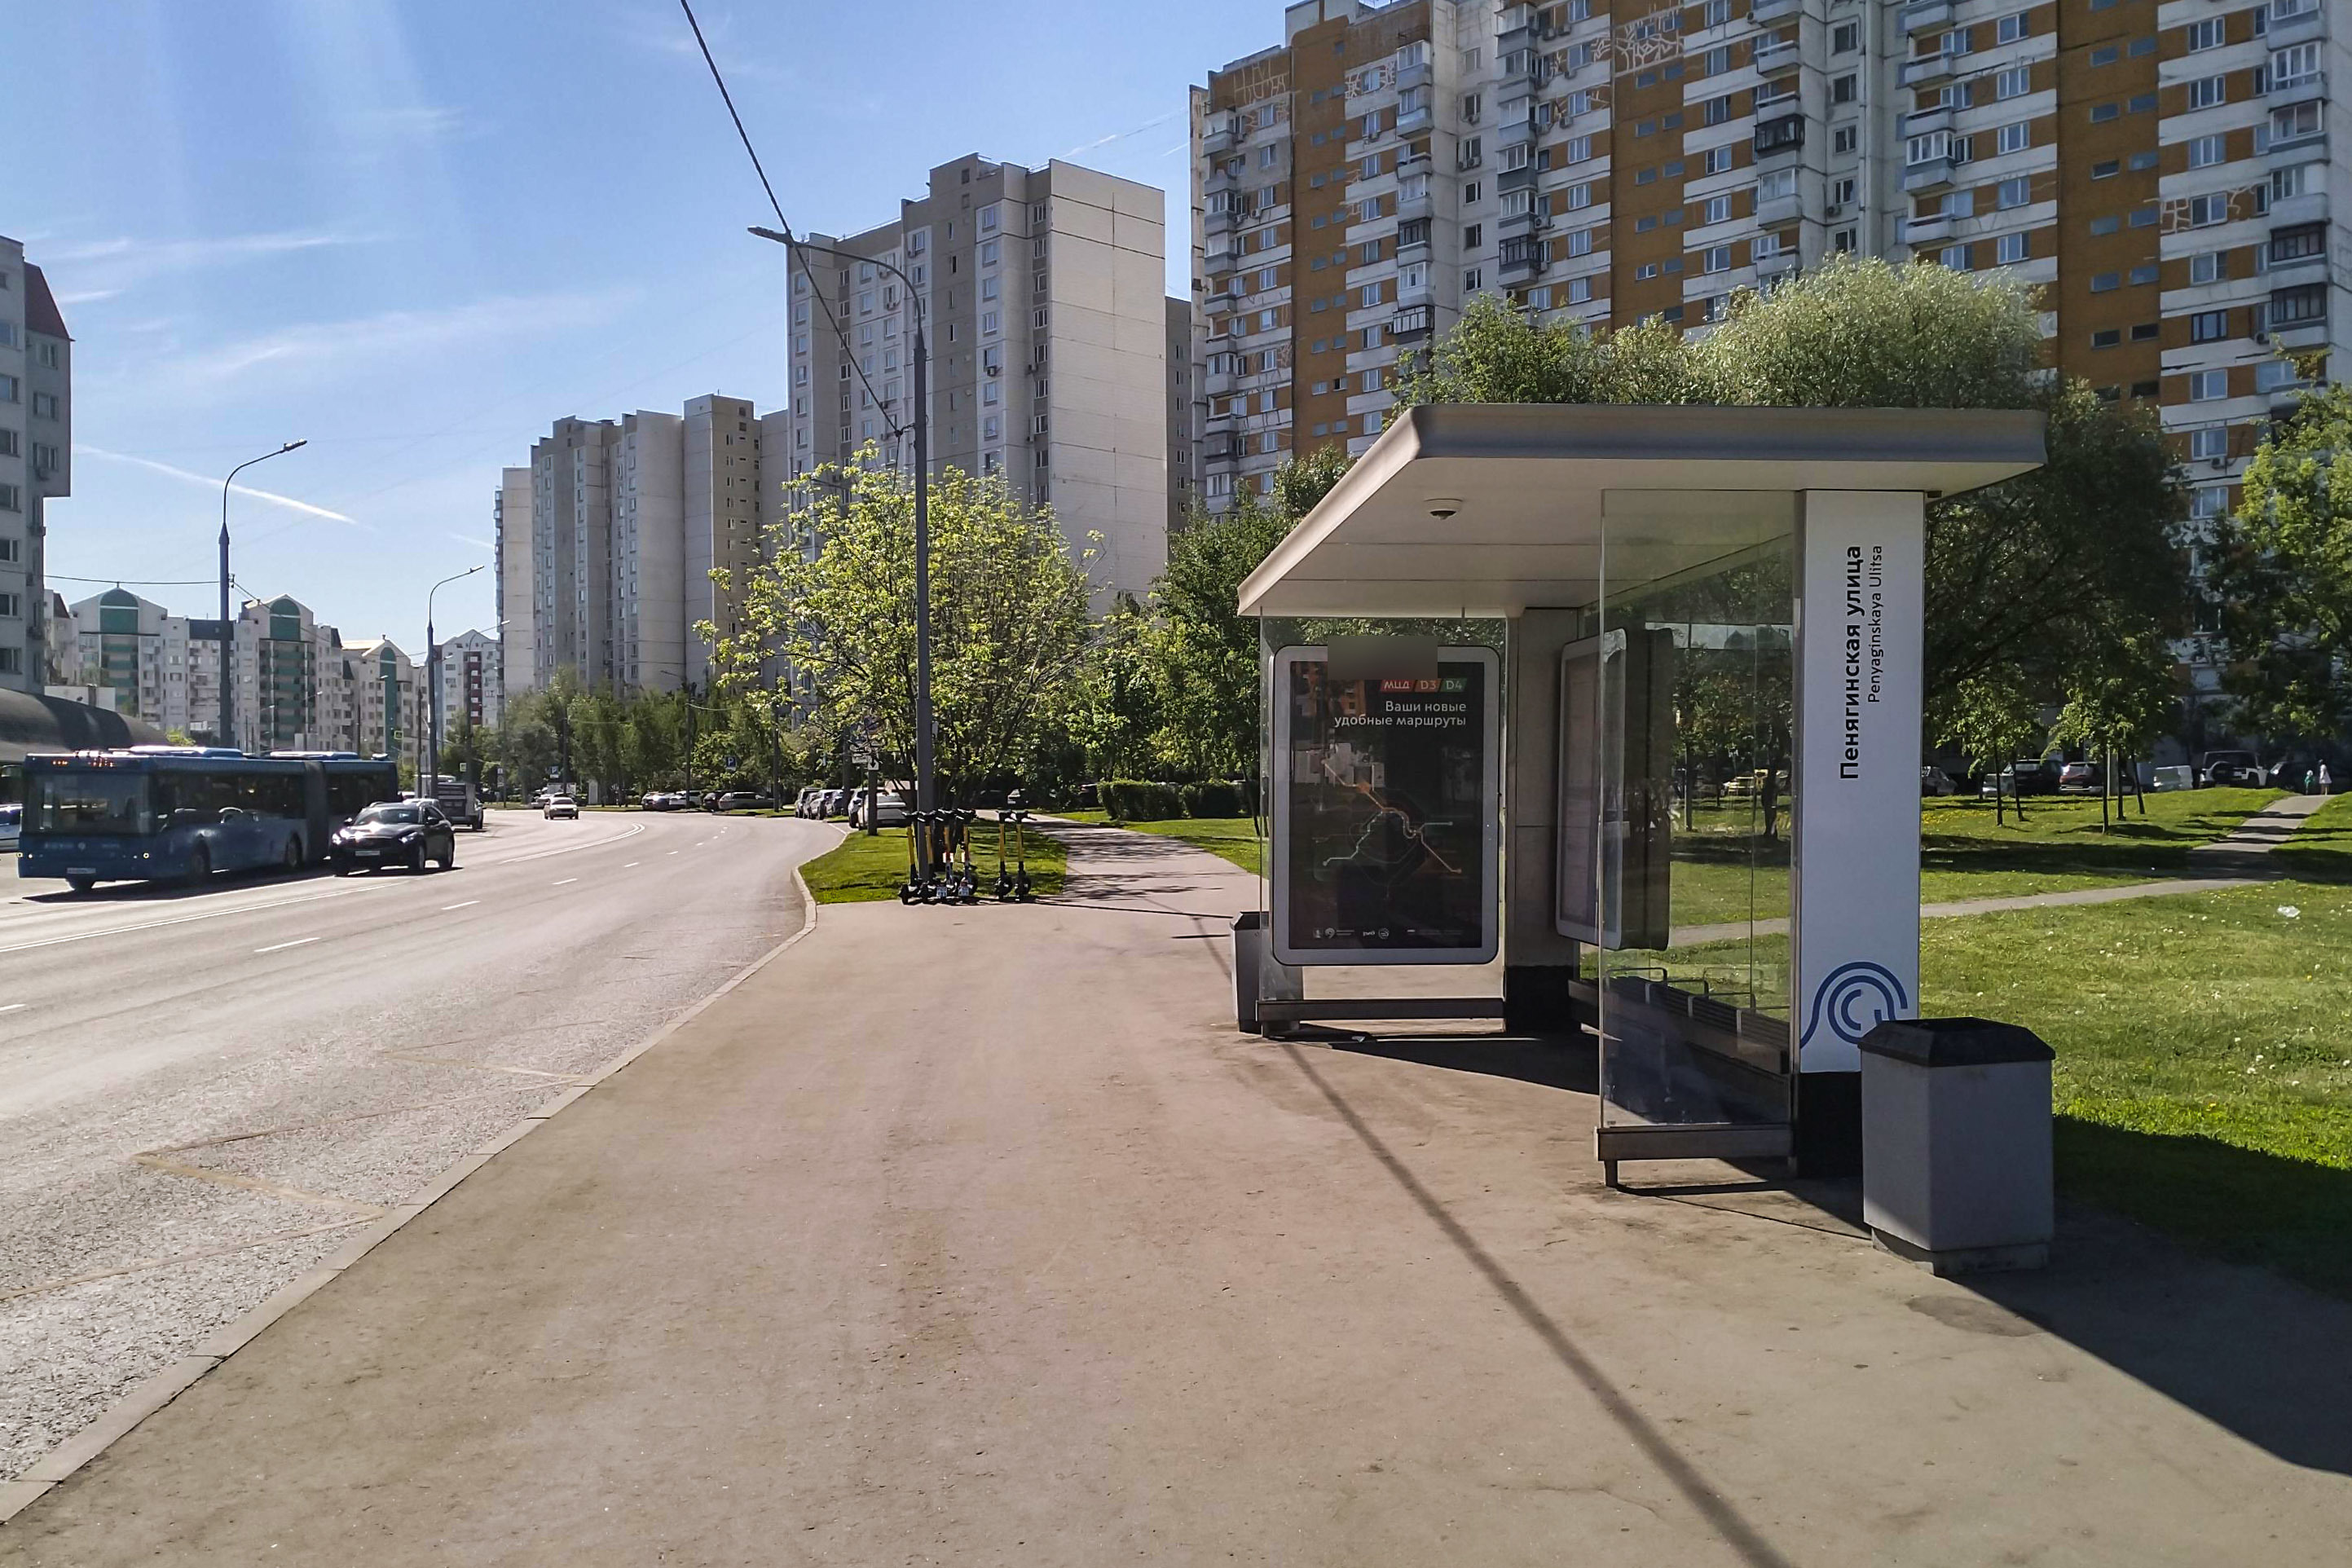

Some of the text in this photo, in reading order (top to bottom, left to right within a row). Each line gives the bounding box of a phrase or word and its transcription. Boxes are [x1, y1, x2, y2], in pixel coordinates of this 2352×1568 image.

[1868, 546, 1884, 703] Penyaginskaya Ulitsa
[1839, 546, 1865, 779] Пенягинская улица
[1384, 680, 1462, 689] МЦД D3 D4
[1385, 701, 1467, 711] Ваши новые
[1334, 714, 1466, 728] удобные маршруты
